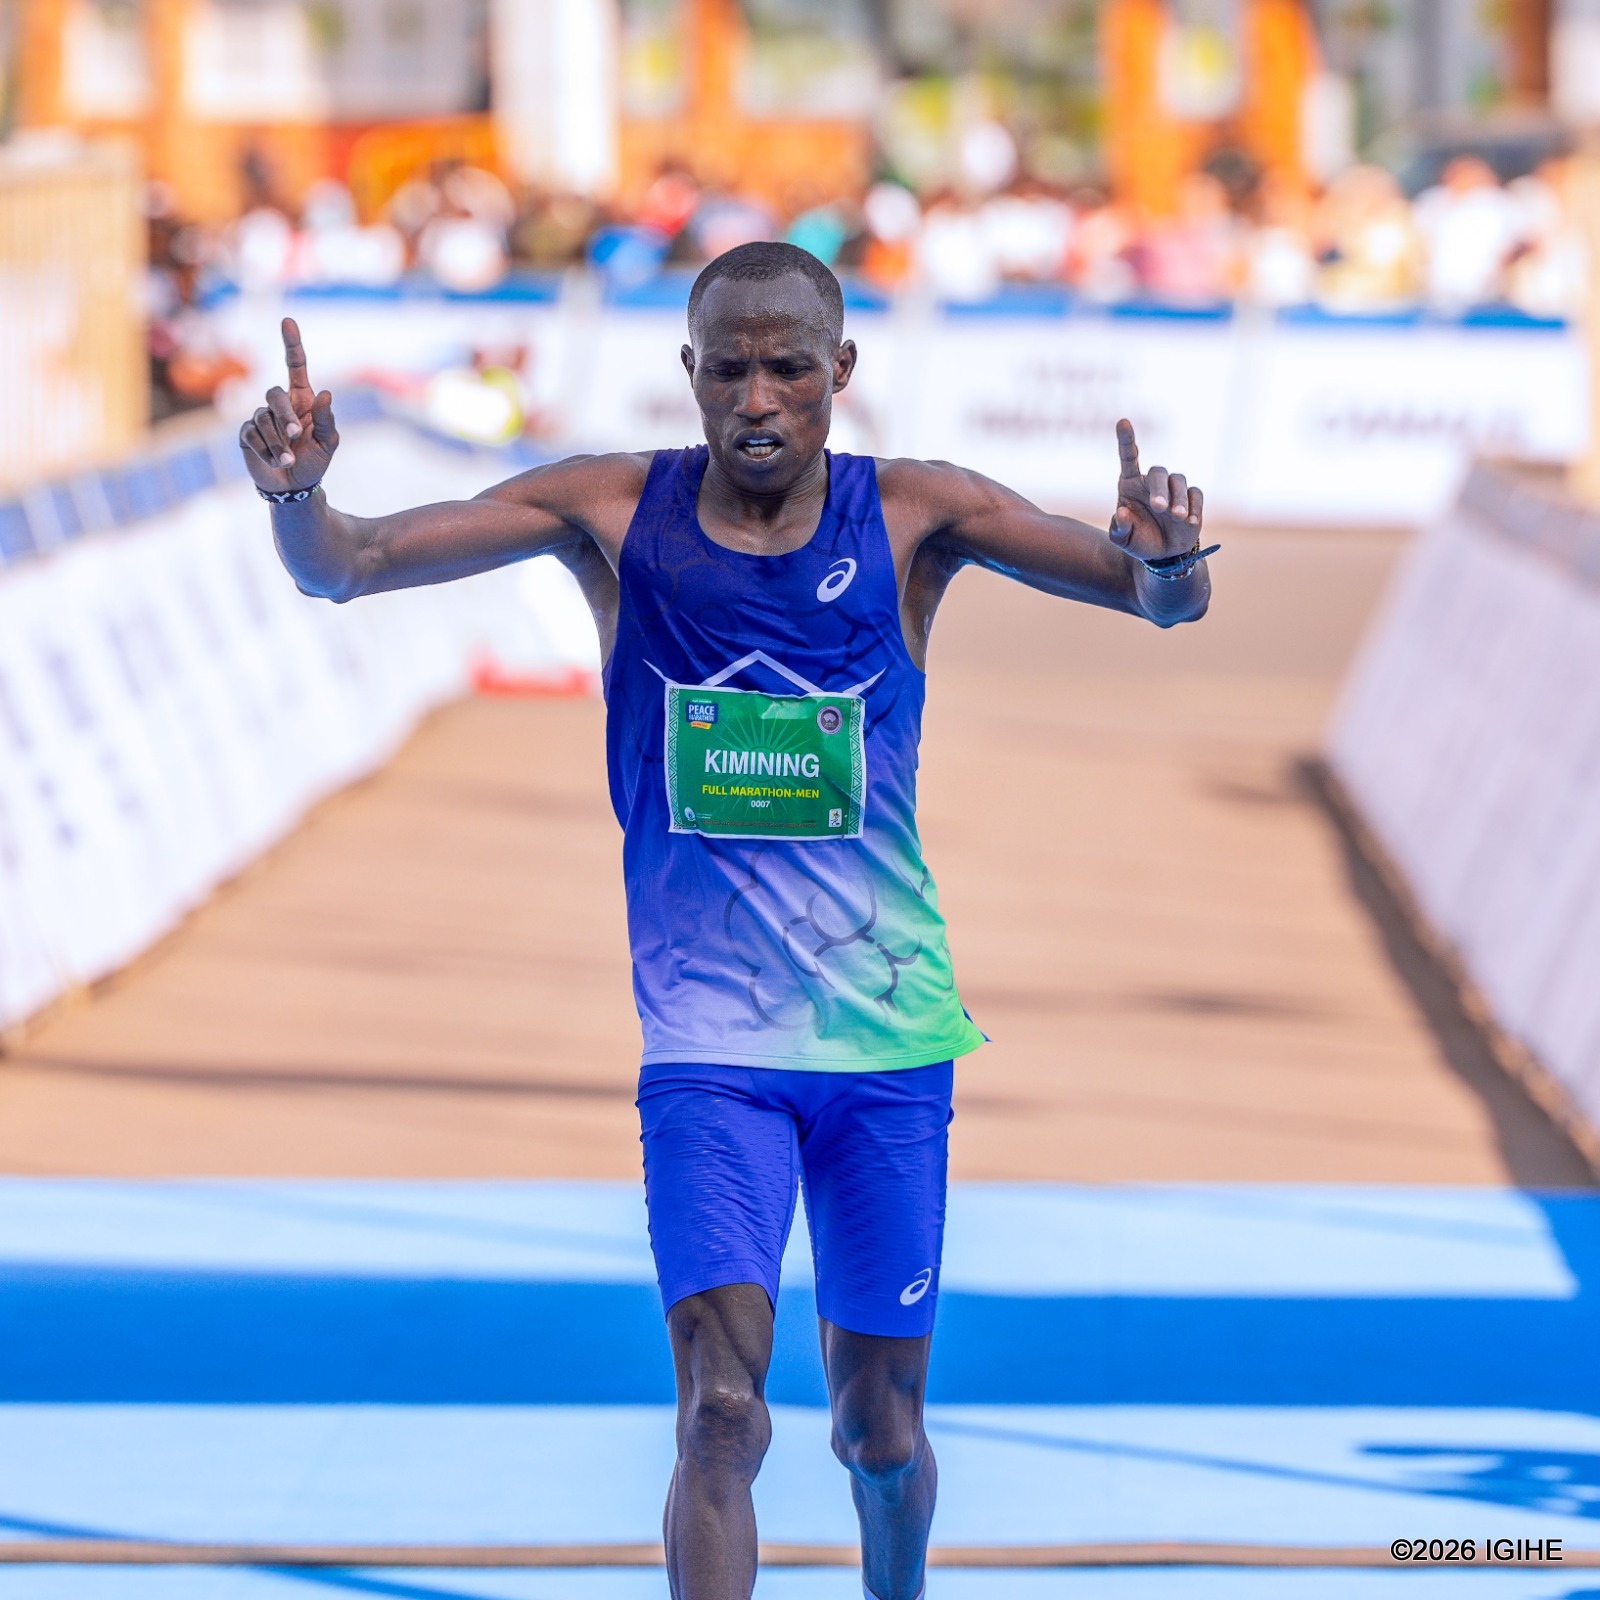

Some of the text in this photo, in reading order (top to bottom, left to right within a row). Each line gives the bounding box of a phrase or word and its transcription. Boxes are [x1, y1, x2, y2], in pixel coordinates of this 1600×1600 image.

[688, 704, 715, 716] PEACE
[704, 749, 820, 778] KIMINING
[702, 785, 820, 799] FULL MARATHON-MEN
[751, 800, 770, 808] 0007
